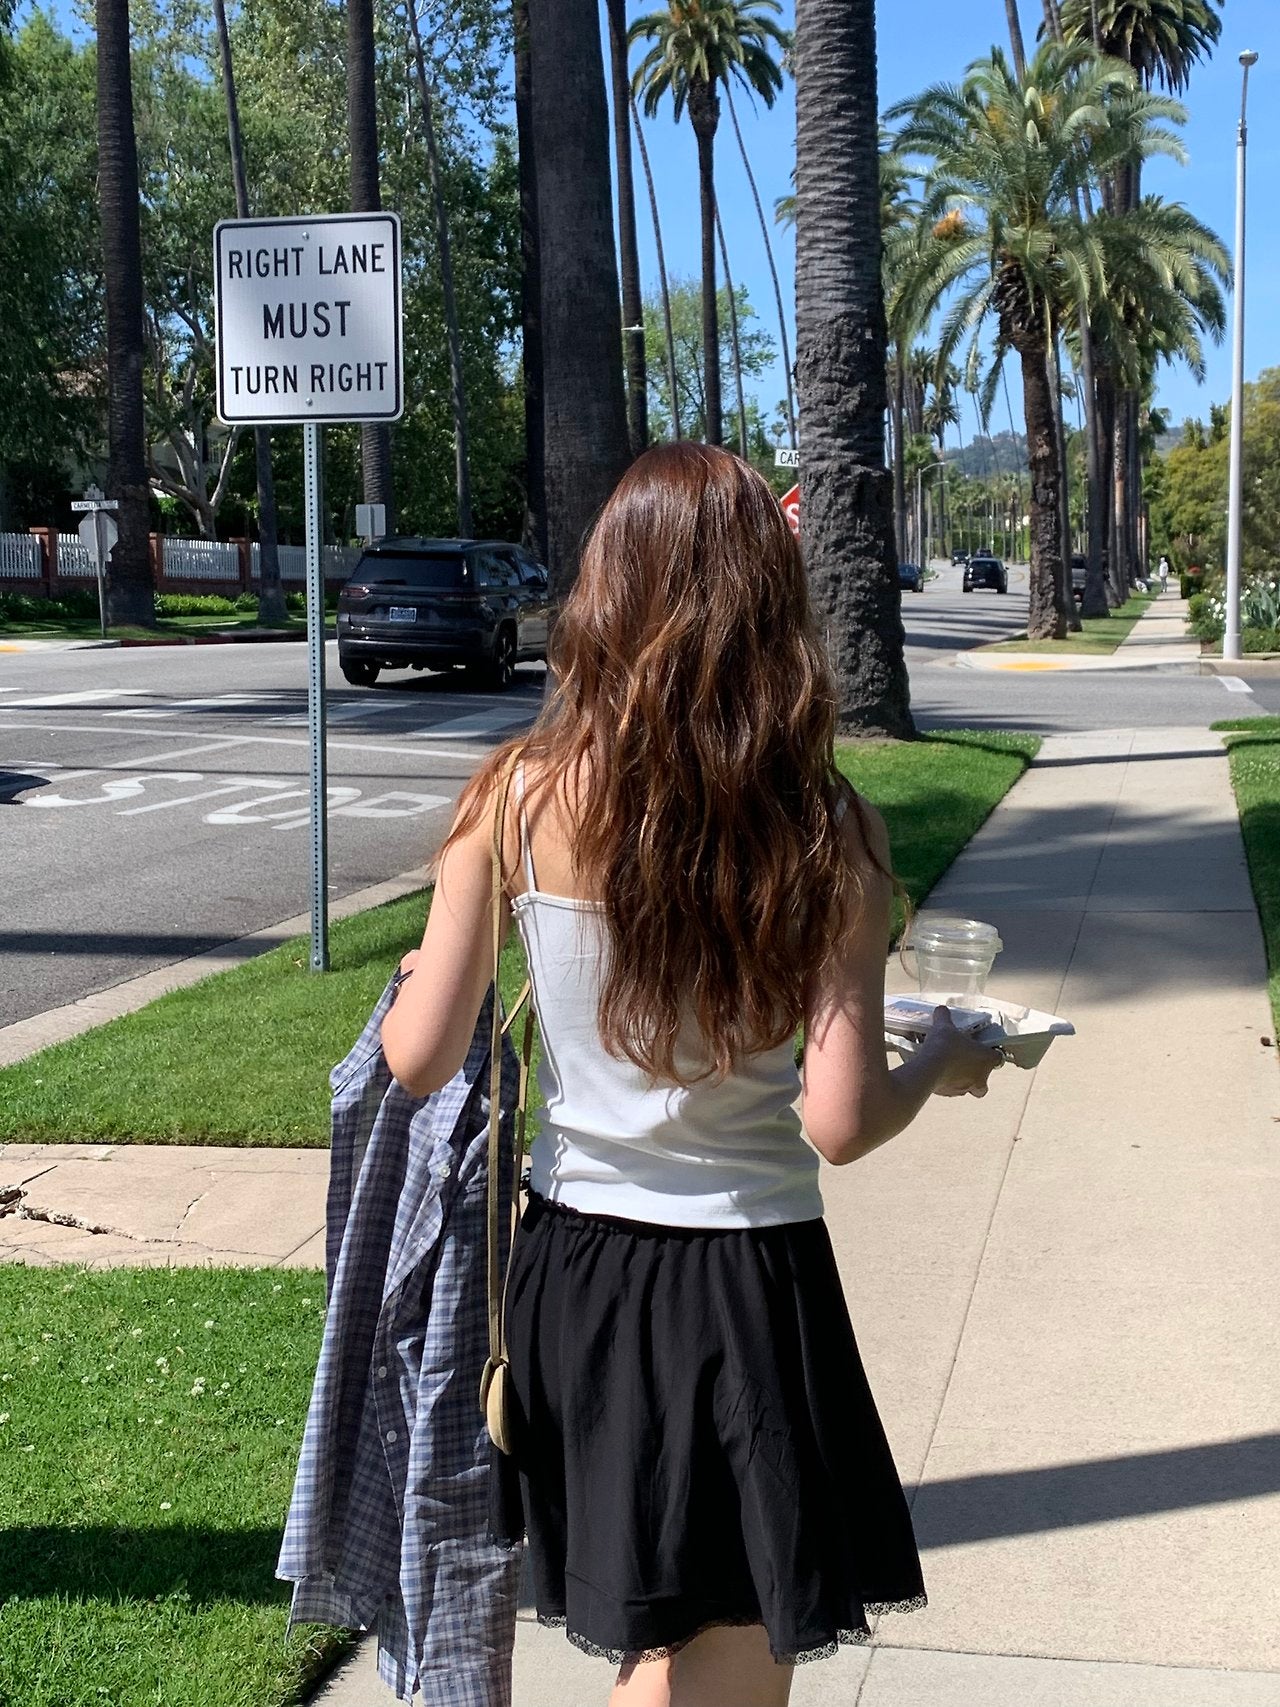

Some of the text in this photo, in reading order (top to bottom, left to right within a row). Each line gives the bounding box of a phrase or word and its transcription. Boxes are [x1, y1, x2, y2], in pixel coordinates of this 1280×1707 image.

[228, 243, 385, 279] RIGHT LANE
[263, 301, 351, 339] MUST
[230, 362, 388, 395] TURN RIGHT
[23, 772, 452, 831] STOP
